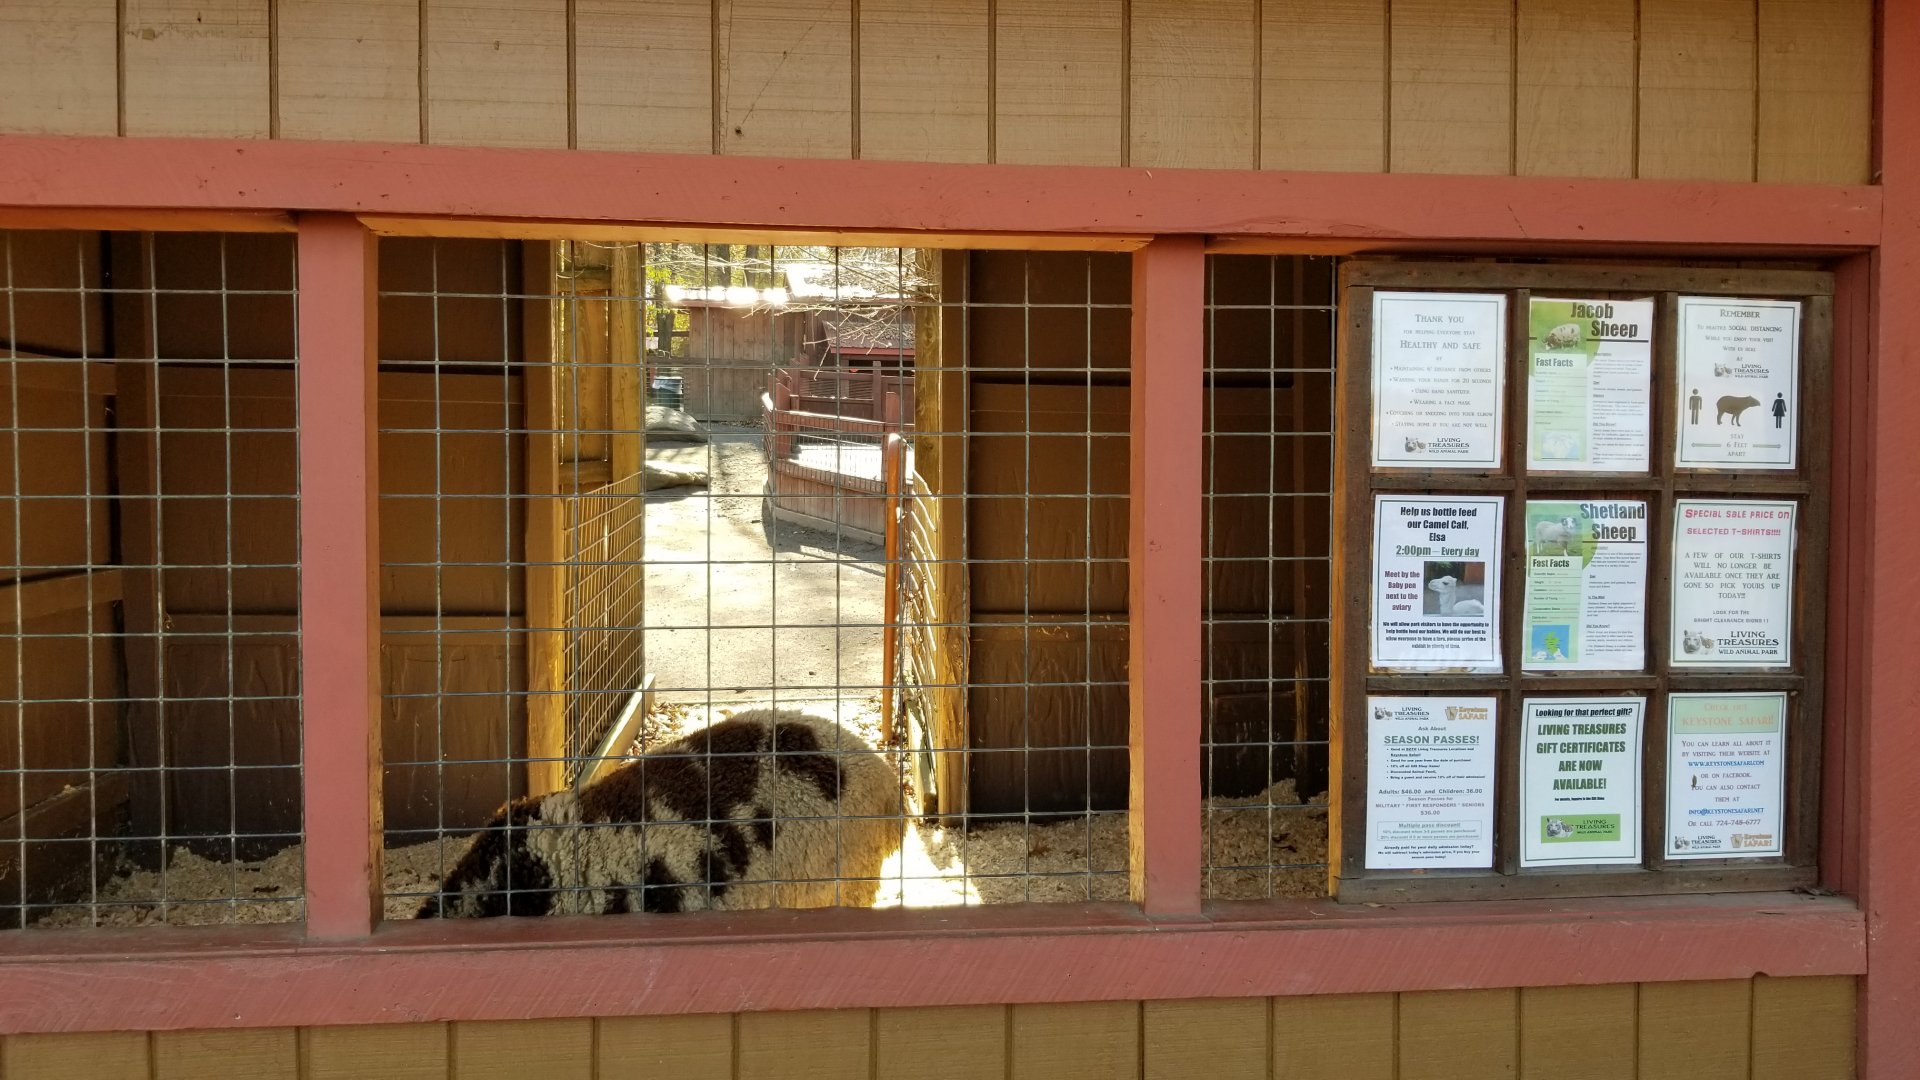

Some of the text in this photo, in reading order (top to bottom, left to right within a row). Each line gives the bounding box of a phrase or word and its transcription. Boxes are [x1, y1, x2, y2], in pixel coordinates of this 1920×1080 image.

[1571, 302, 1613, 319] Jacob
[1720, 309, 1760, 318] REMEMBER
[1415, 314, 1443, 323] THANK
[1591, 320, 1638, 338] Sheep
[1400, 340, 1437, 348] HEALTHY
[1536, 358, 1573, 367] Fast Facts
[1401, 507, 1419, 516] Help
[1433, 508, 1457, 516] bottle
[1459, 508, 1477, 516] feed
[1580, 504, 1645, 519] Shetland
[1423, 520, 1449, 528] Camel
[1451, 521, 1468, 530] Calf,
[1429, 533, 1445, 541] Elsa
[1592, 524, 1636, 541] Sheep
[1396, 545, 1479, 557] 2:00pm Every day
[1533, 559, 1569, 568] Fast Facts
[1536, 709, 1562, 717] Looking
[1590, 708, 1615, 717] perfect
[1617, 708, 1632, 717] gift?
[1538, 723, 1626, 735] LIVING TREASURES
[1537, 741, 1626, 753] GIFT CERTIFICATES
[1559, 760, 1602, 772] ARE NOW
[1553, 778, 1606, 790] AVAILABLE!
